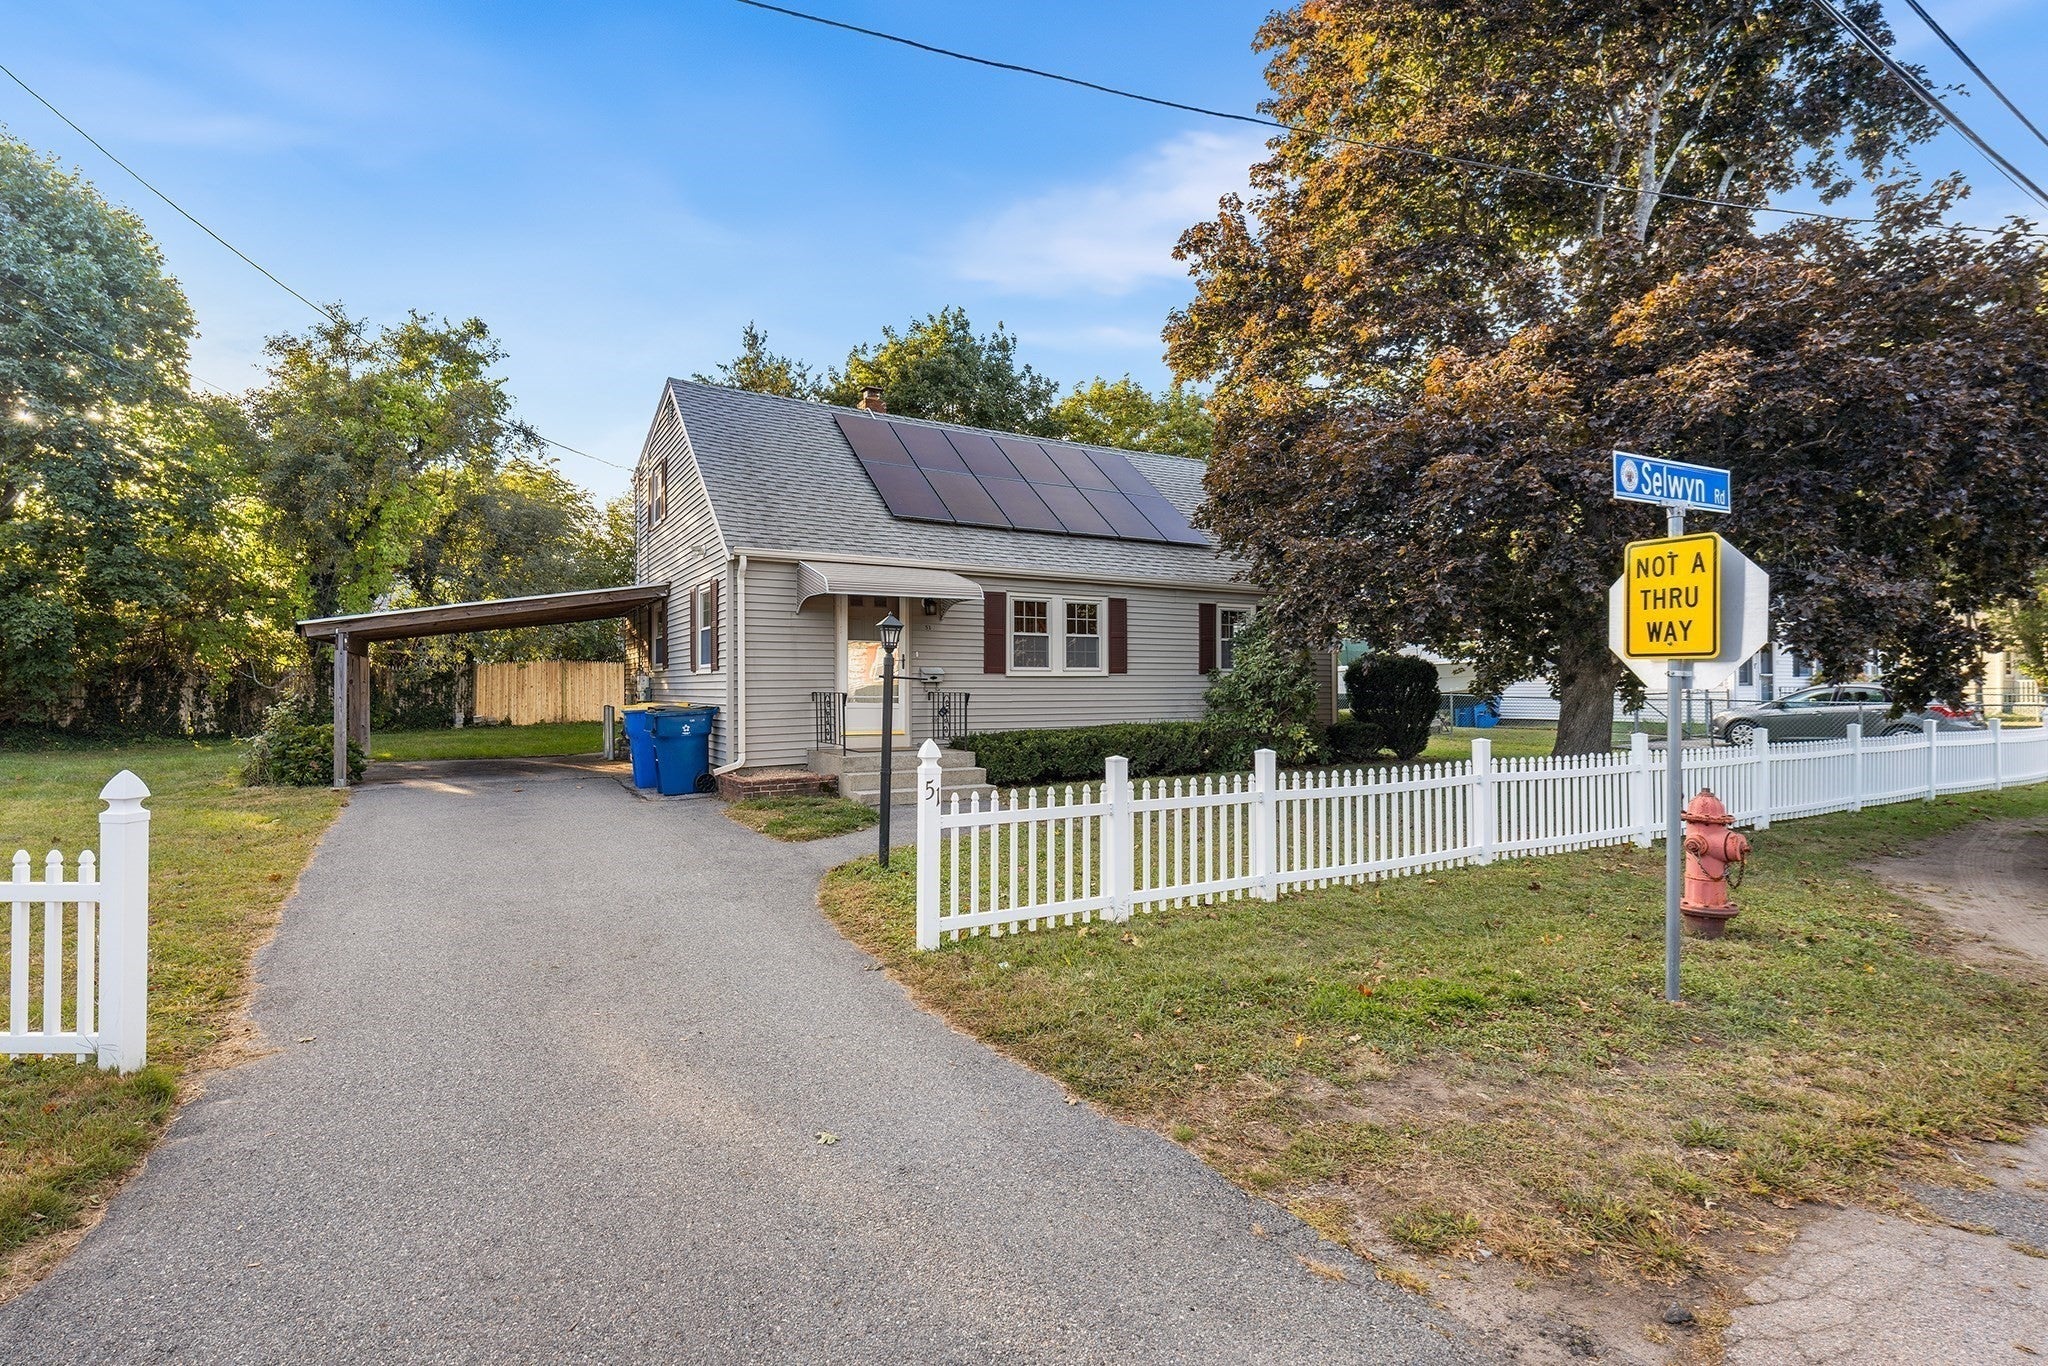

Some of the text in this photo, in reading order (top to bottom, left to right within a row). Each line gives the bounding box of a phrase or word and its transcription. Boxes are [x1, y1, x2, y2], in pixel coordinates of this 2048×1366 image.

[1641, 461, 1705, 502] Selwyn
[1714, 488, 1725, 505] Rd
[1636, 551, 1705, 578] NOT A
[1640, 585, 1698, 611] THRU
[1646, 620, 1693, 642] WAY
[925, 779, 940, 807] 51
